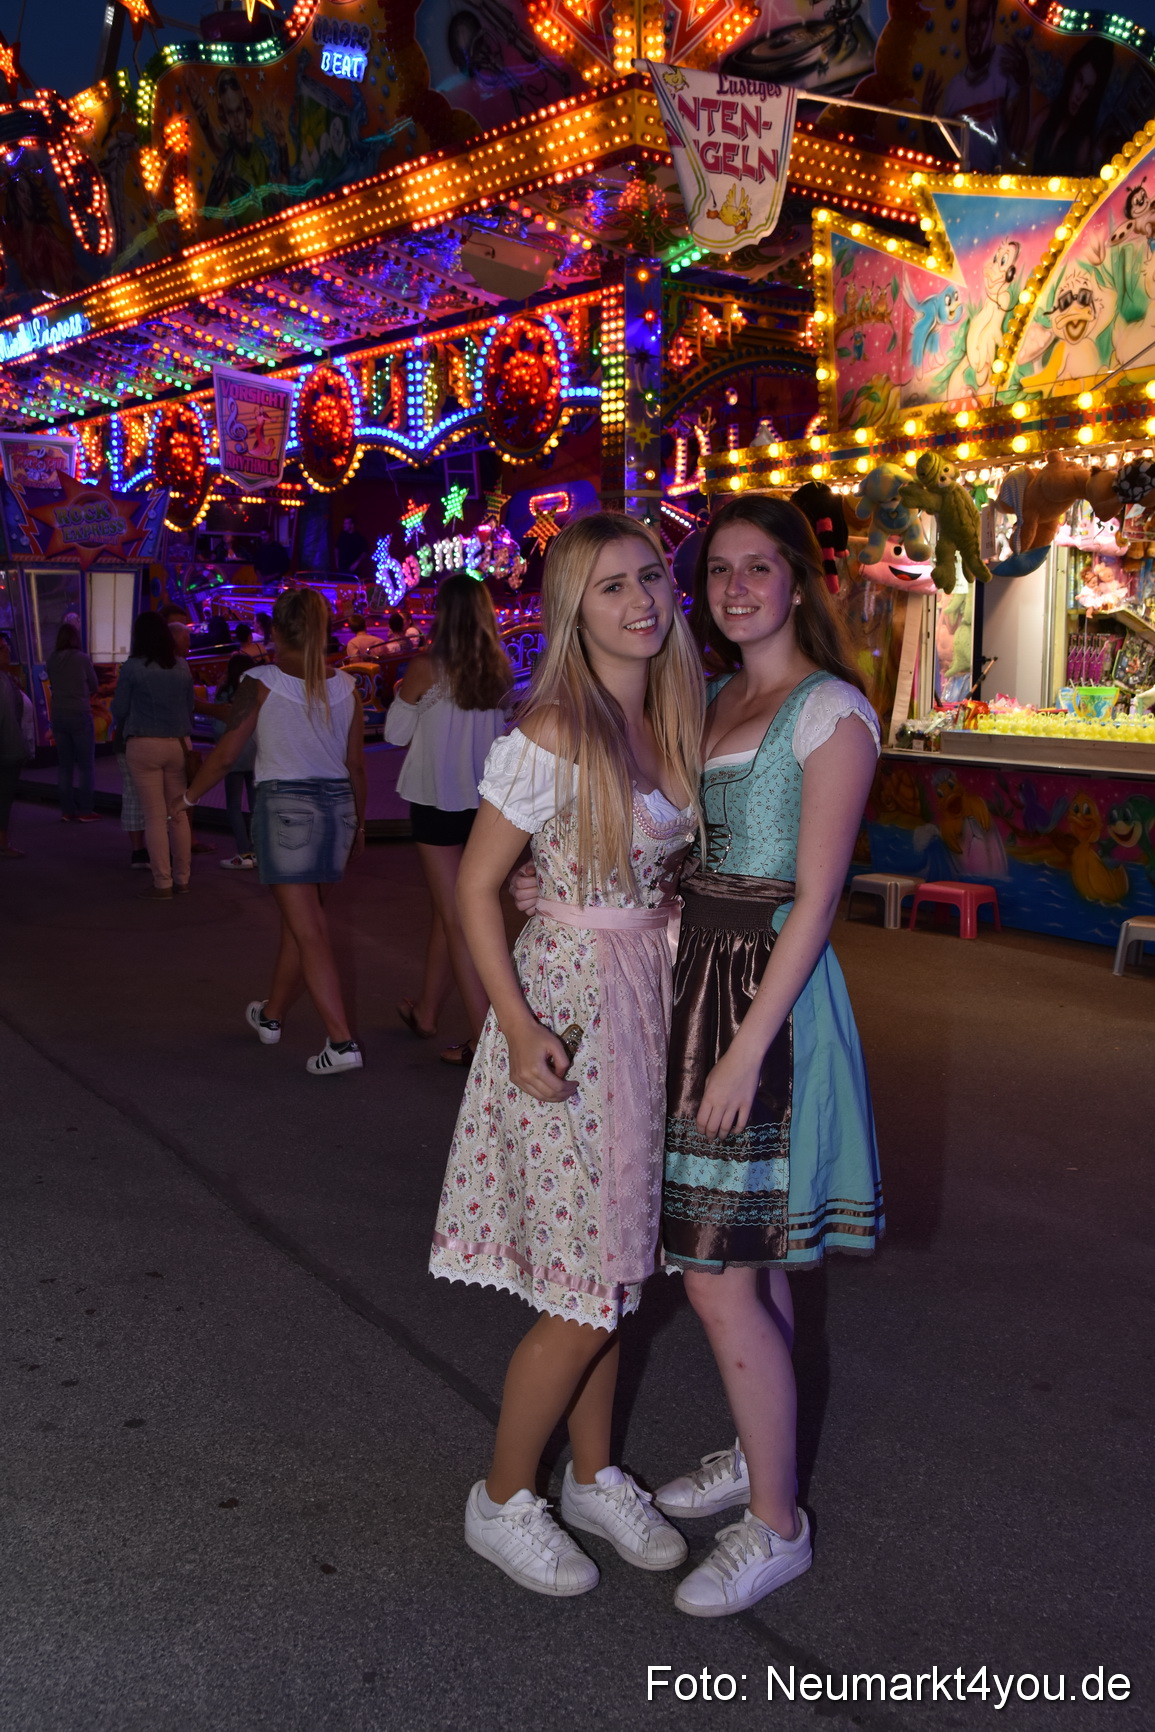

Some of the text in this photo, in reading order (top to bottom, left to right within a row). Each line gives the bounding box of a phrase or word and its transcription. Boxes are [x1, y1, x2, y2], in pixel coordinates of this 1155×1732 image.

[320, 51, 367, 78] BEAT
[676, 94, 772, 141] NTEN-
[221, 380, 287, 410] VORSICHT
[869, 434, 938, 458] LUSTIGE
[225, 451, 280, 478] RHYTHMUS
[54, 502, 110, 525] ROCK
[63, 518, 125, 541] EXPRESS
